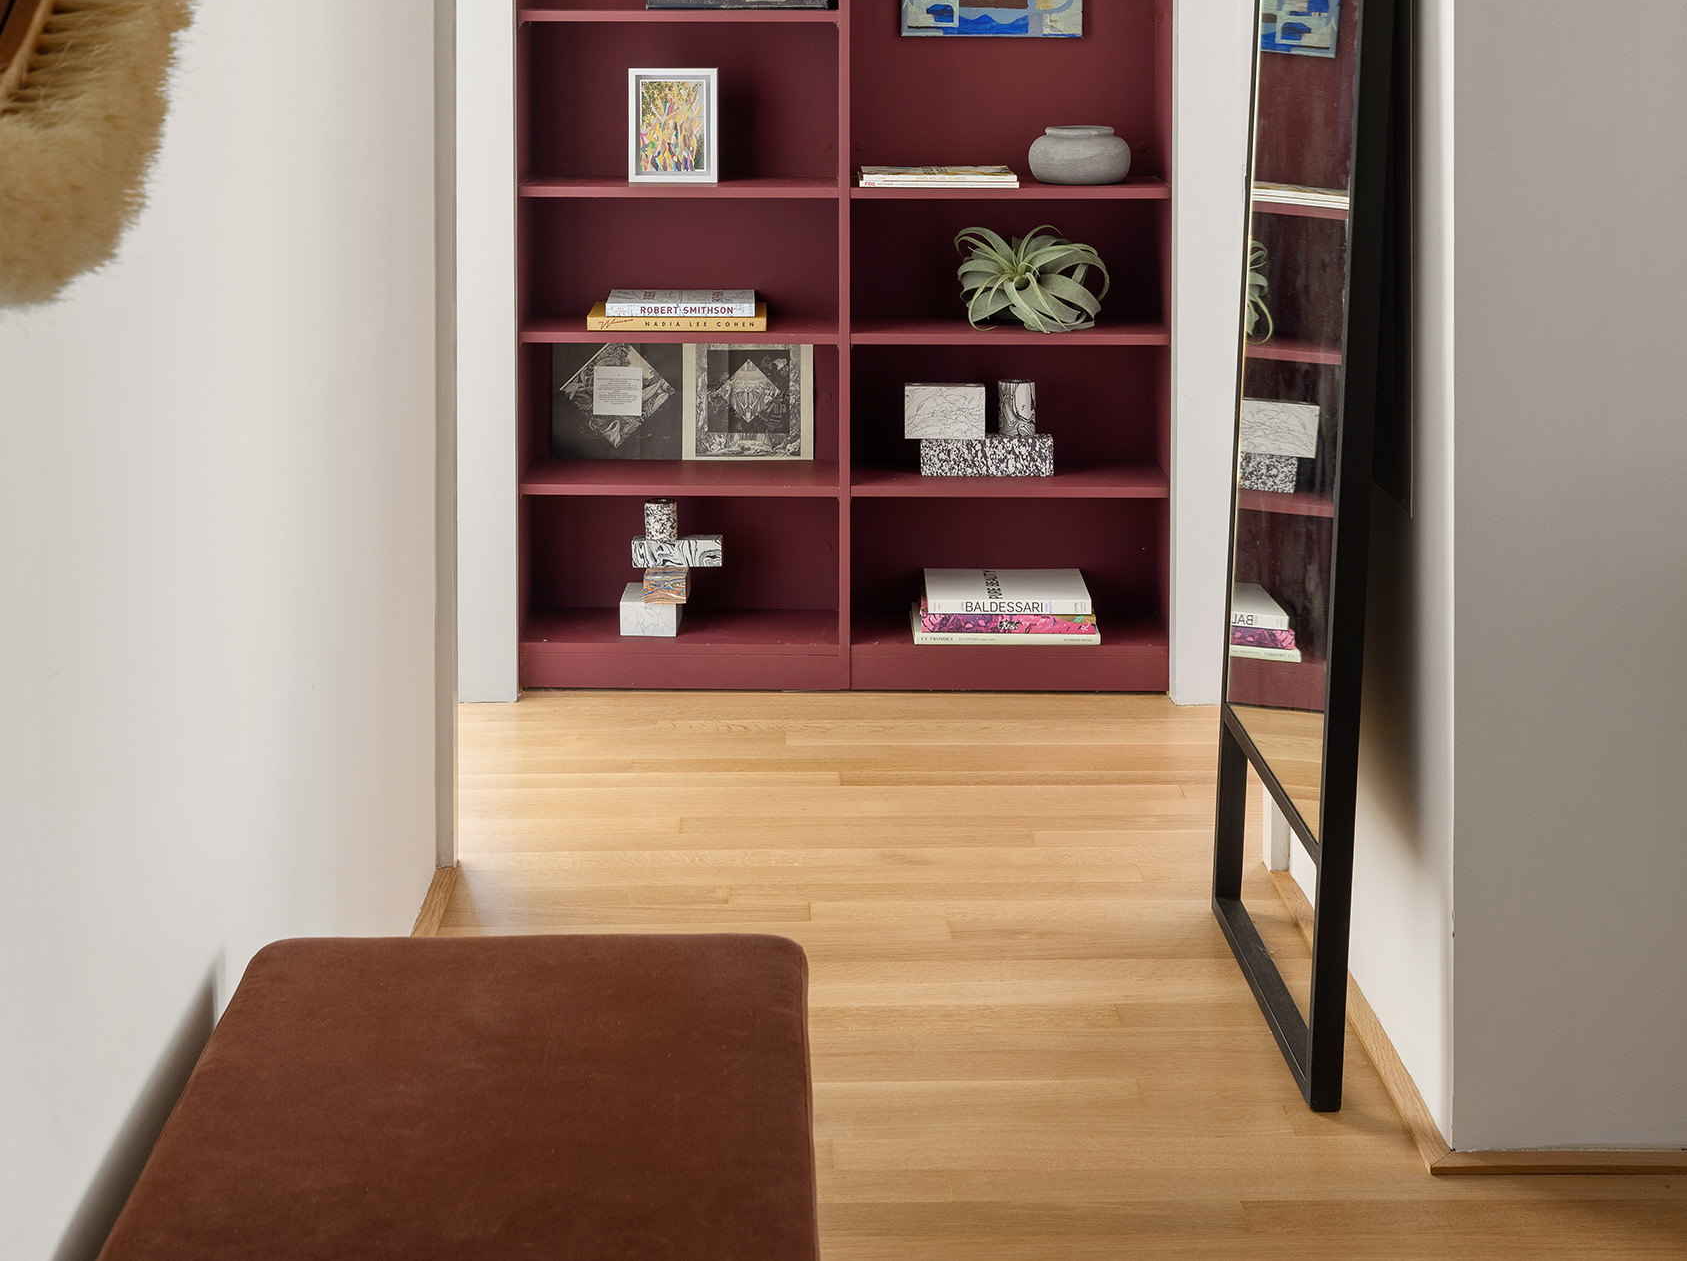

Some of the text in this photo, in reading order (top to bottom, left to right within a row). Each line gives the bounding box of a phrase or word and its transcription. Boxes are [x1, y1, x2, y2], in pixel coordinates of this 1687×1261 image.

[640, 306, 734, 314] ROBERT SMITHSON
[965, 601, 1044, 613] BALDESSARI
